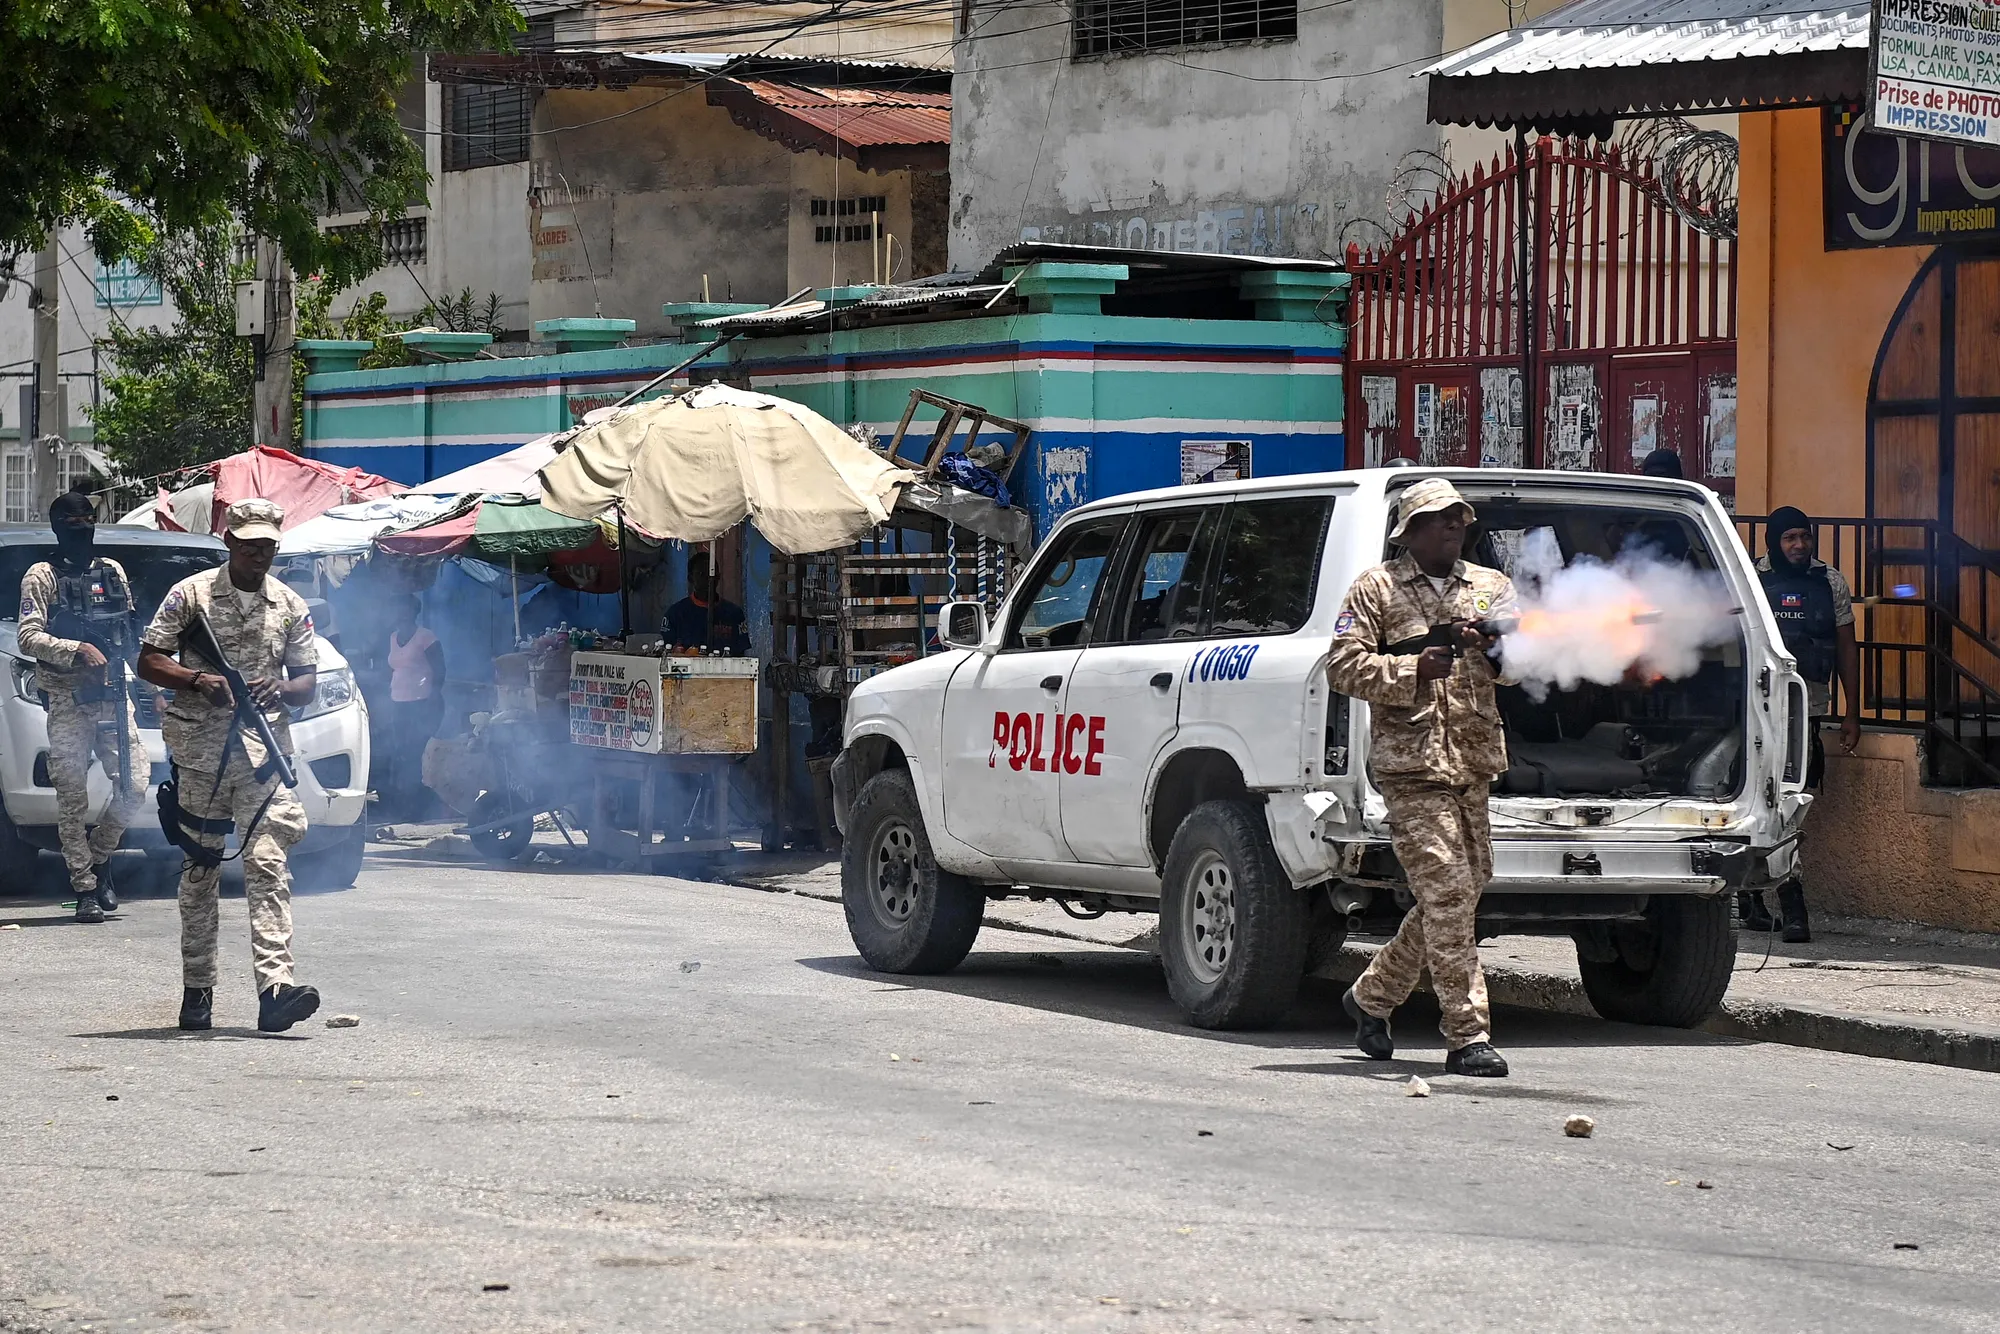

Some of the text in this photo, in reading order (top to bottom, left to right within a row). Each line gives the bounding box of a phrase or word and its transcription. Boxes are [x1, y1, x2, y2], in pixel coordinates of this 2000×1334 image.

[1882, 0, 1968, 28] IMPRESSION
[1939, 26, 1975, 43] PHOTOS
[1881, 36, 1958, 63] FORMULAIRE
[1977, 69, 2000, 85] FAX
[1878, 80, 2000, 118] Prise de PHOTO
[1887, 105, 1986, 137] IMPRESSION
[1917, 203, 1995, 236] Impression
[1774, 611, 1806, 620] POLIC
[988, 711, 1106, 776] POLICE
